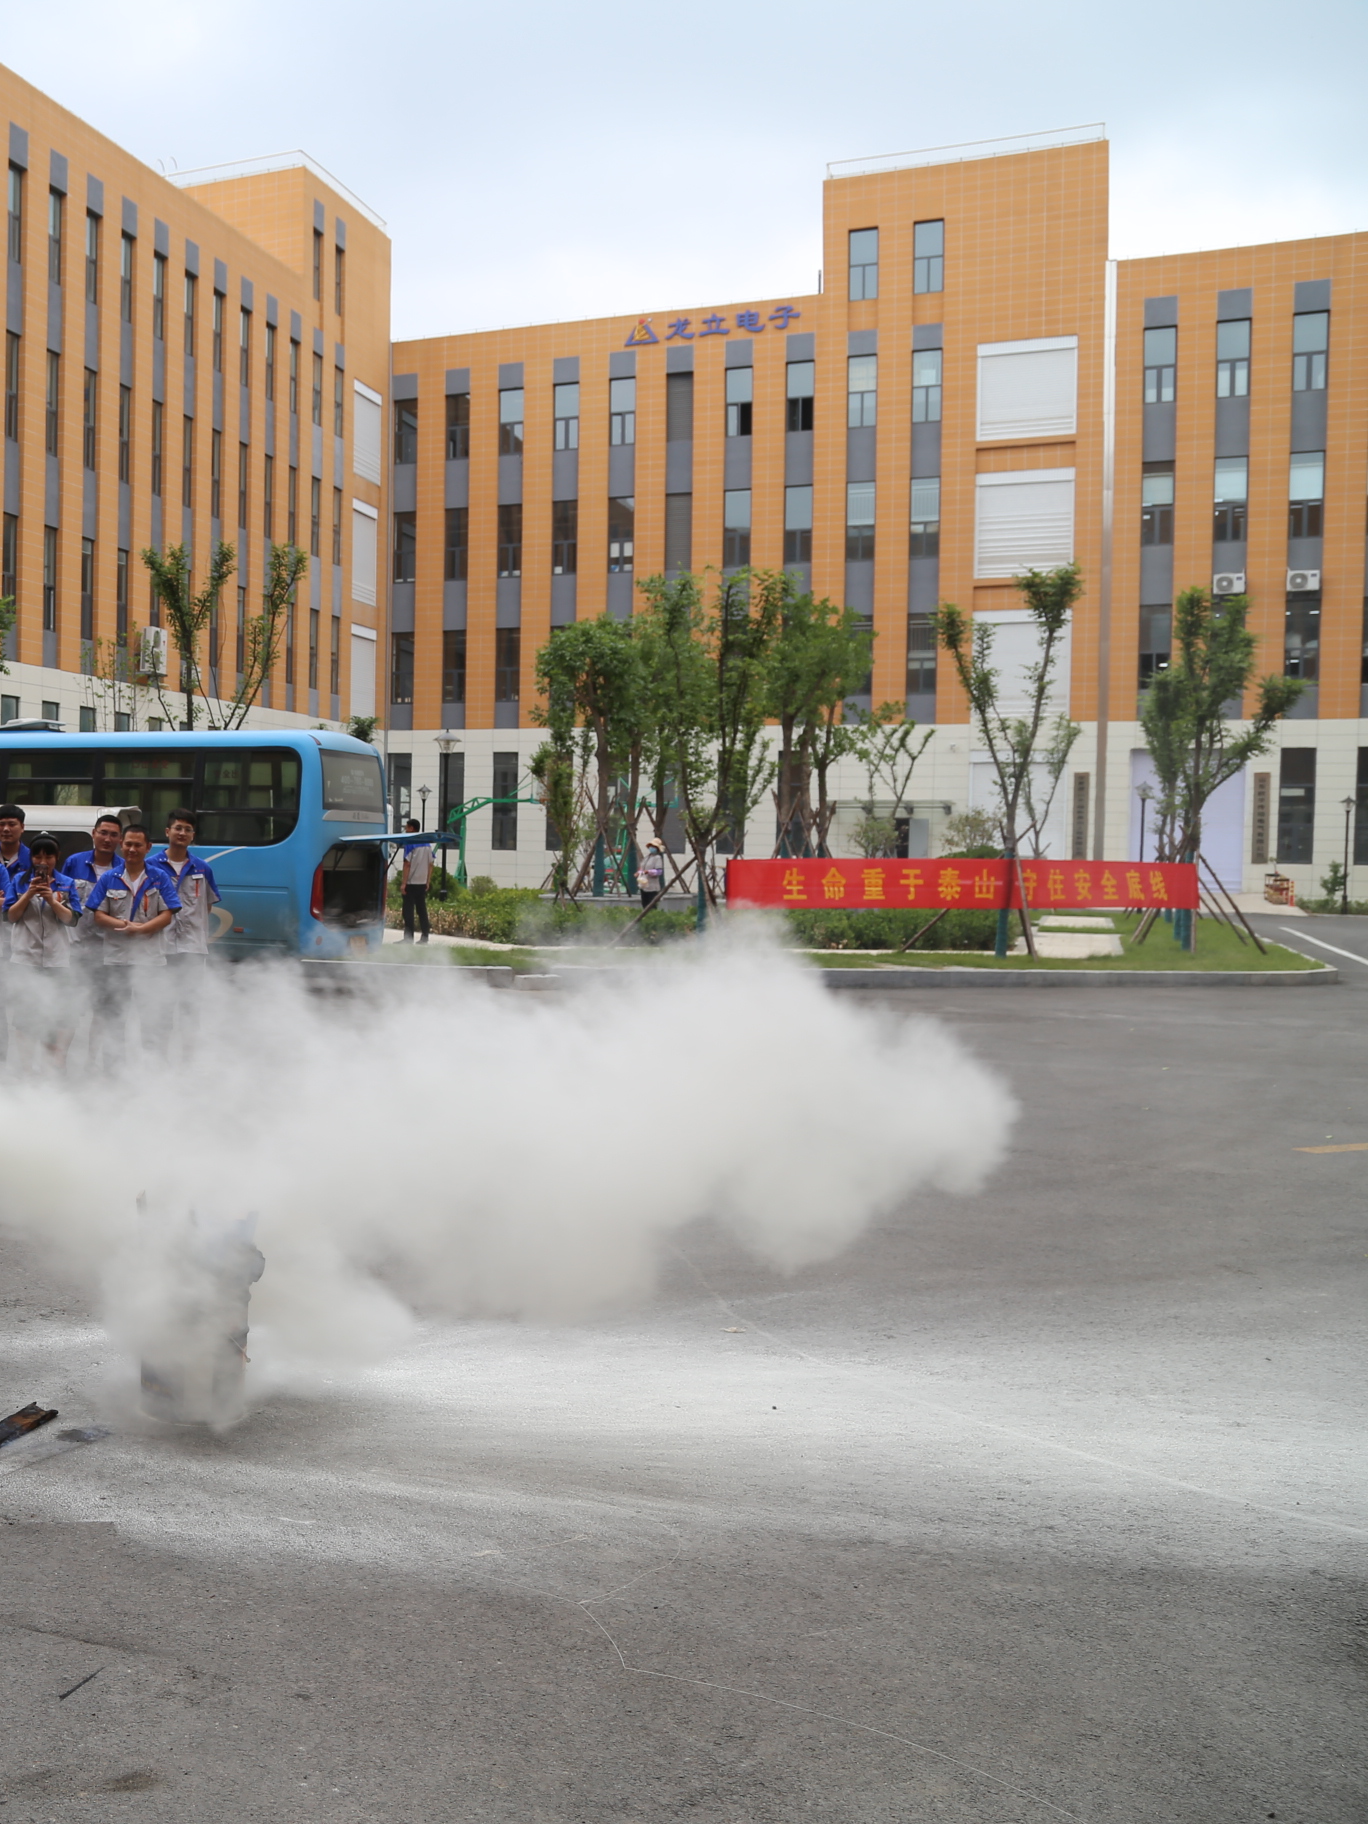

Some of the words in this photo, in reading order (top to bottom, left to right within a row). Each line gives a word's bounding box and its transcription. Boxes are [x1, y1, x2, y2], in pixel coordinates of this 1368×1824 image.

[665, 305, 801, 340] 龙立电子
[783, 867, 996, 901] 生命重于泰山
[1021, 868, 1169, 902] 守住安全底线
